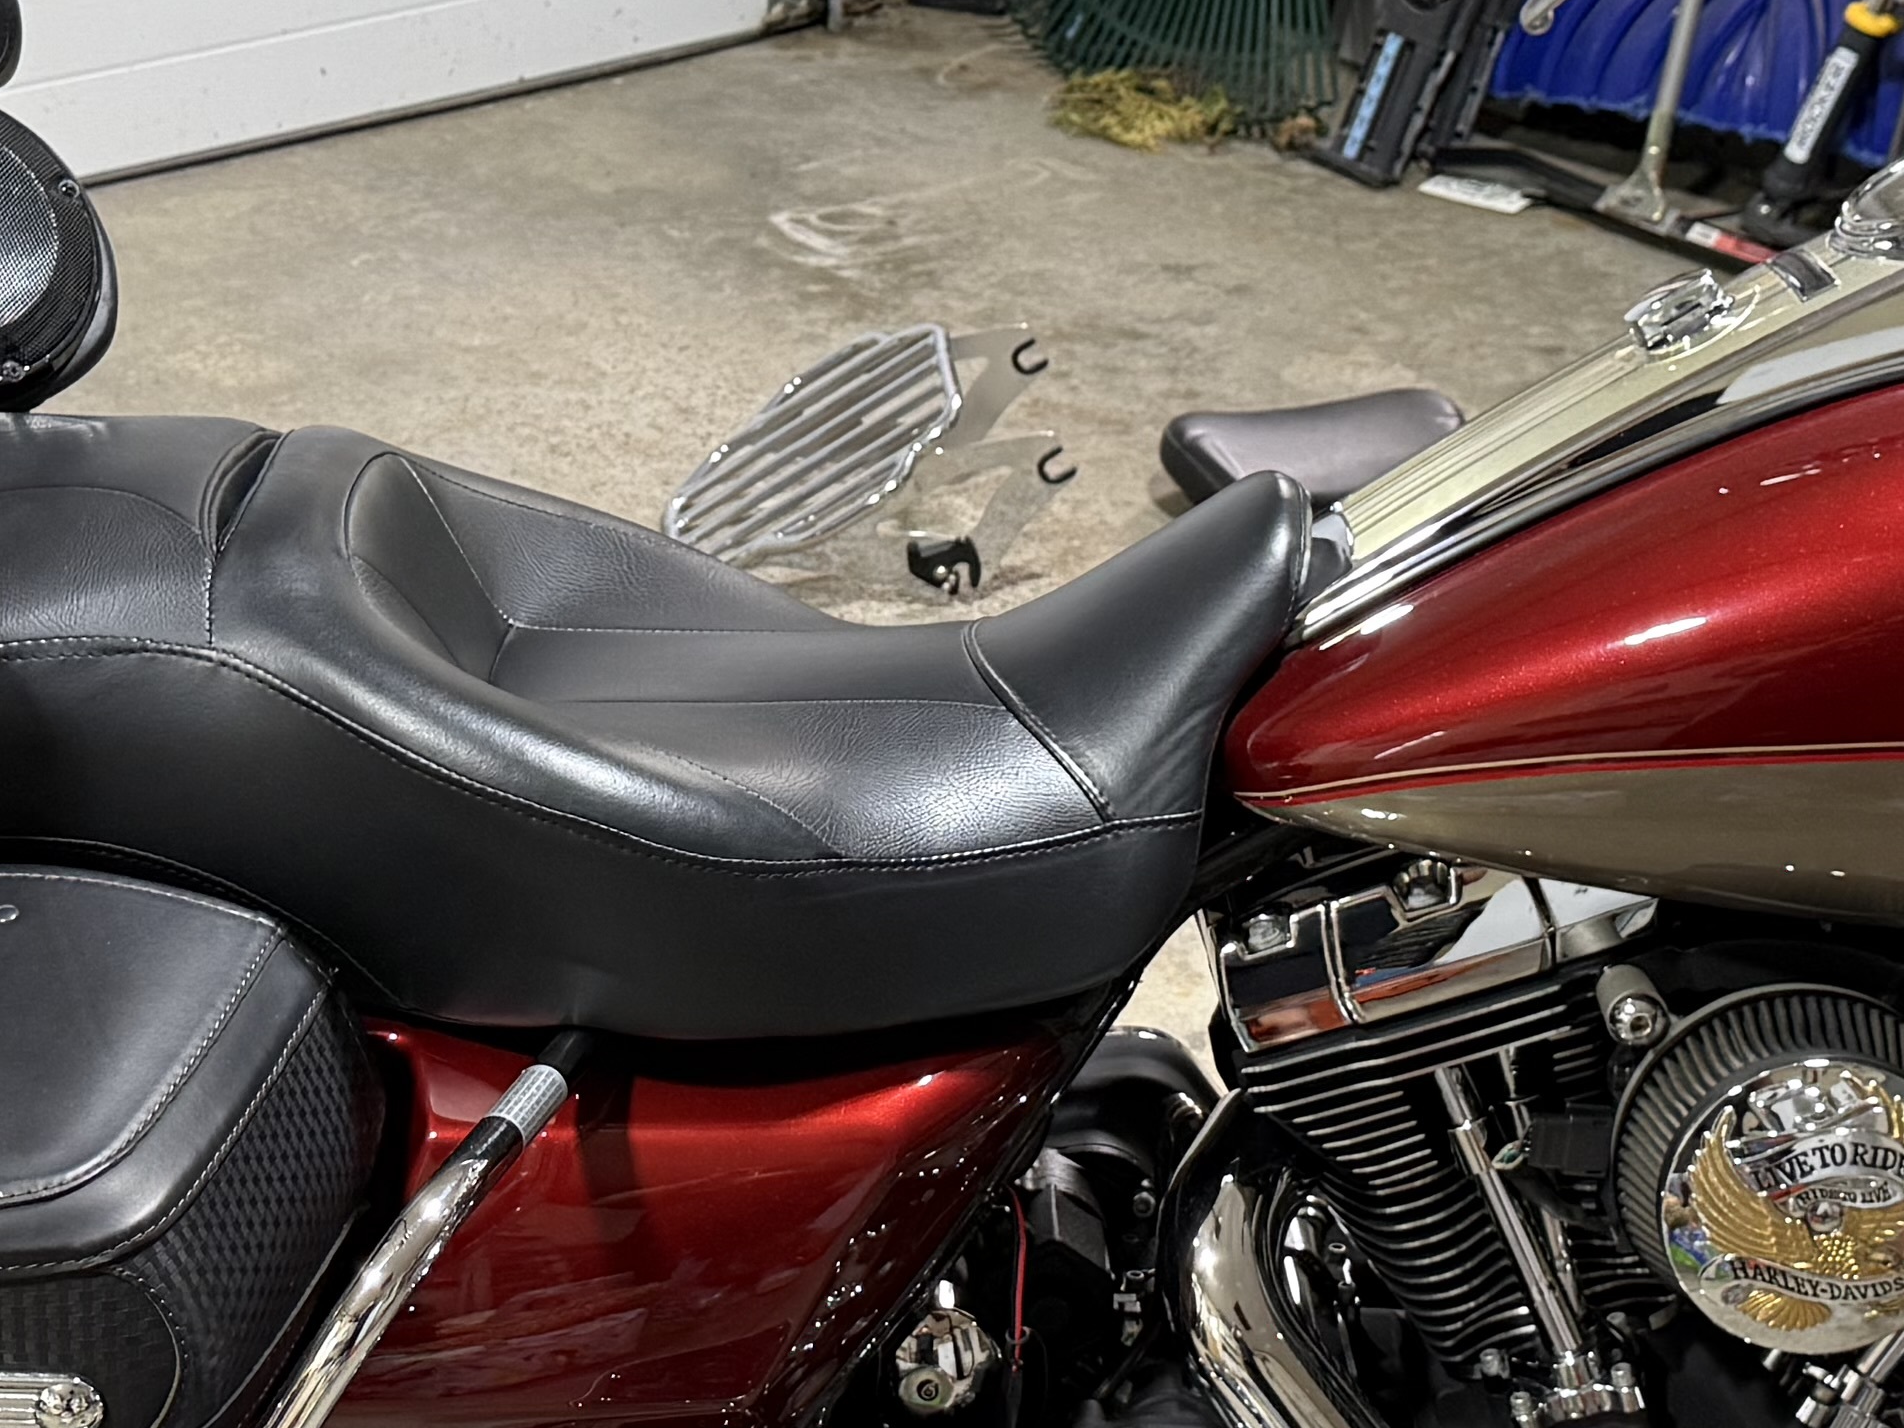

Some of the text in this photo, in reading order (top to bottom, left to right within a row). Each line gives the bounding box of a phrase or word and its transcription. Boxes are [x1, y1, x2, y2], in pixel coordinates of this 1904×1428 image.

[1751, 1152, 1815, 1192] LIVE
[1812, 1143, 1847, 1169] TO
[1861, 1181, 1893, 1204] LIVE
